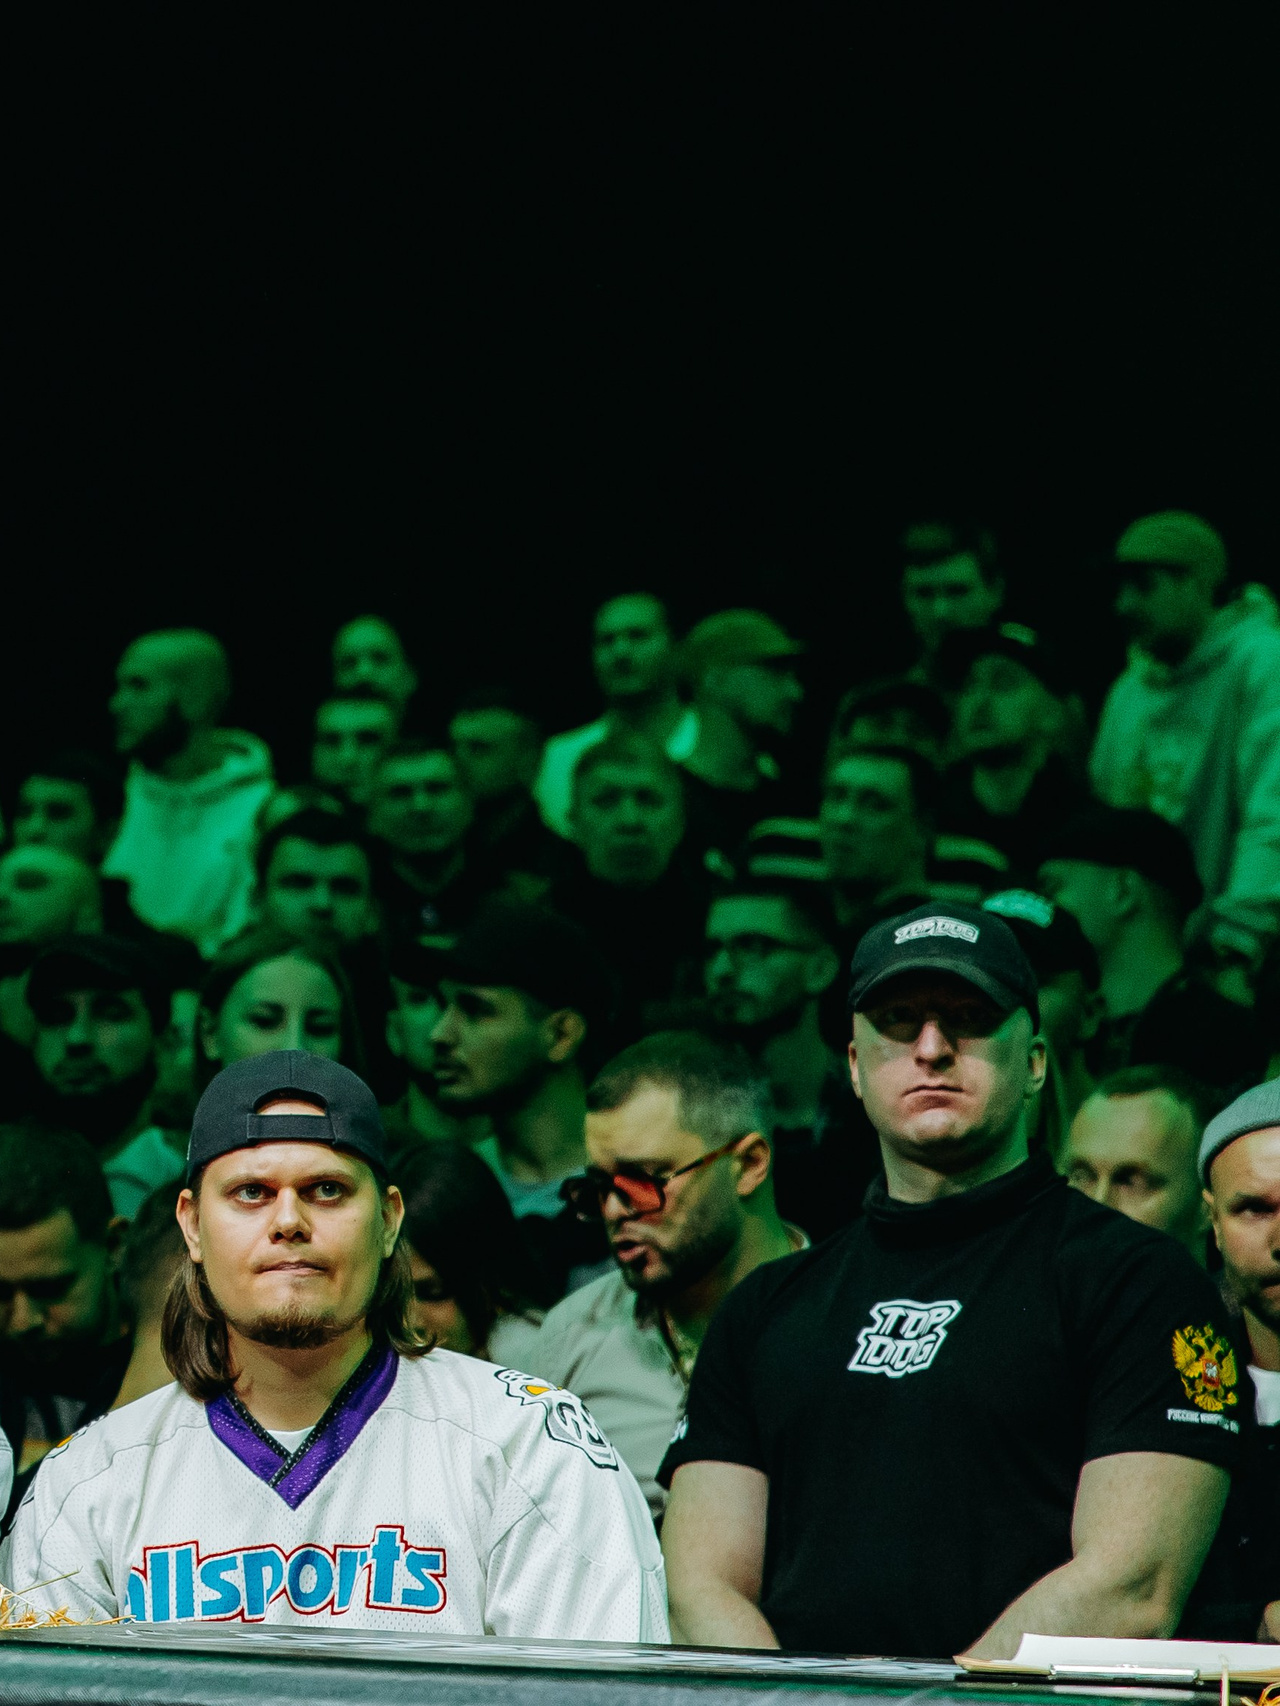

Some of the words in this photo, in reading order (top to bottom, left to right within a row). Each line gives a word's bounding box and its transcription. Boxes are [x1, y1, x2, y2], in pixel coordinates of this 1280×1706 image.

[895, 918, 937, 943] TOP
[933, 917, 979, 943] DOG
[878, 1304, 953, 1339] TOP
[859, 1333, 938, 1370] DOG
